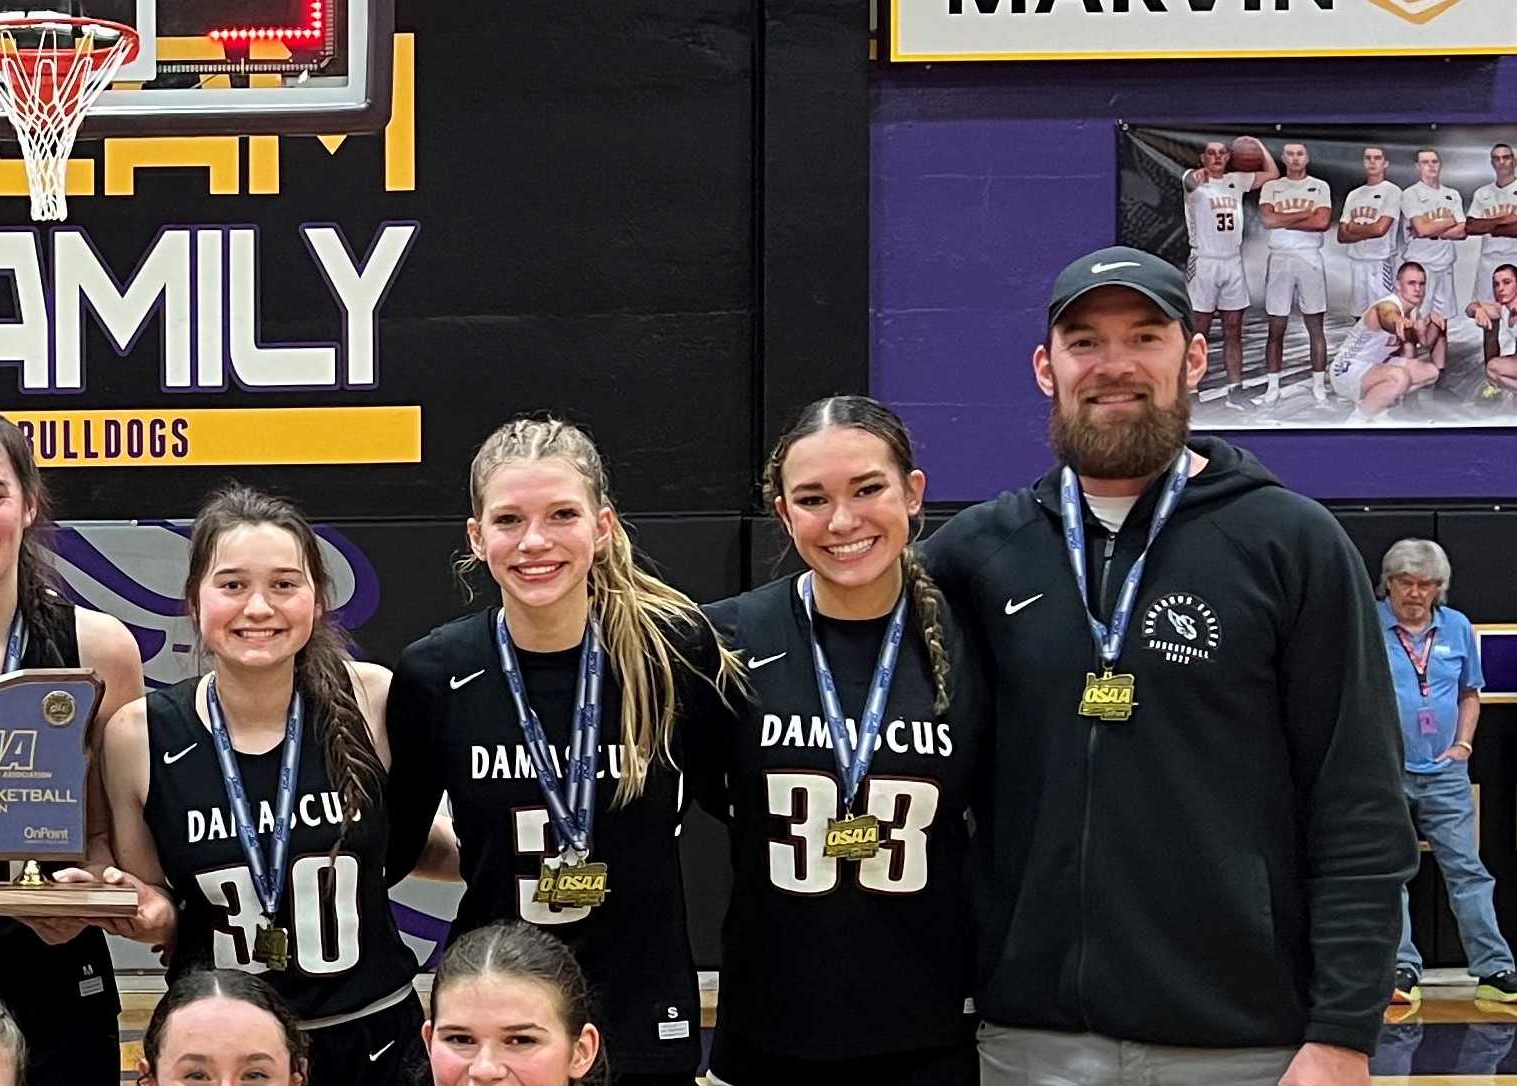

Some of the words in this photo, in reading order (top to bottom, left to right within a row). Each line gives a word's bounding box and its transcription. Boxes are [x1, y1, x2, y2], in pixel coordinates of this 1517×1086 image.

[1216, 213, 1234, 232] 33
[1084, 686, 1131, 704] OSAA
[760, 713, 954, 757] DAMCUS
[187, 791, 362, 843] DAACU
[24, 826, 68, 839] OnPoint
[765, 772, 940, 894] 33
[826, 827, 877, 846] OSAA
[559, 876, 604, 890] OSAA
[194, 854, 360, 975] 30
[667, 1006, 679, 1018] S
